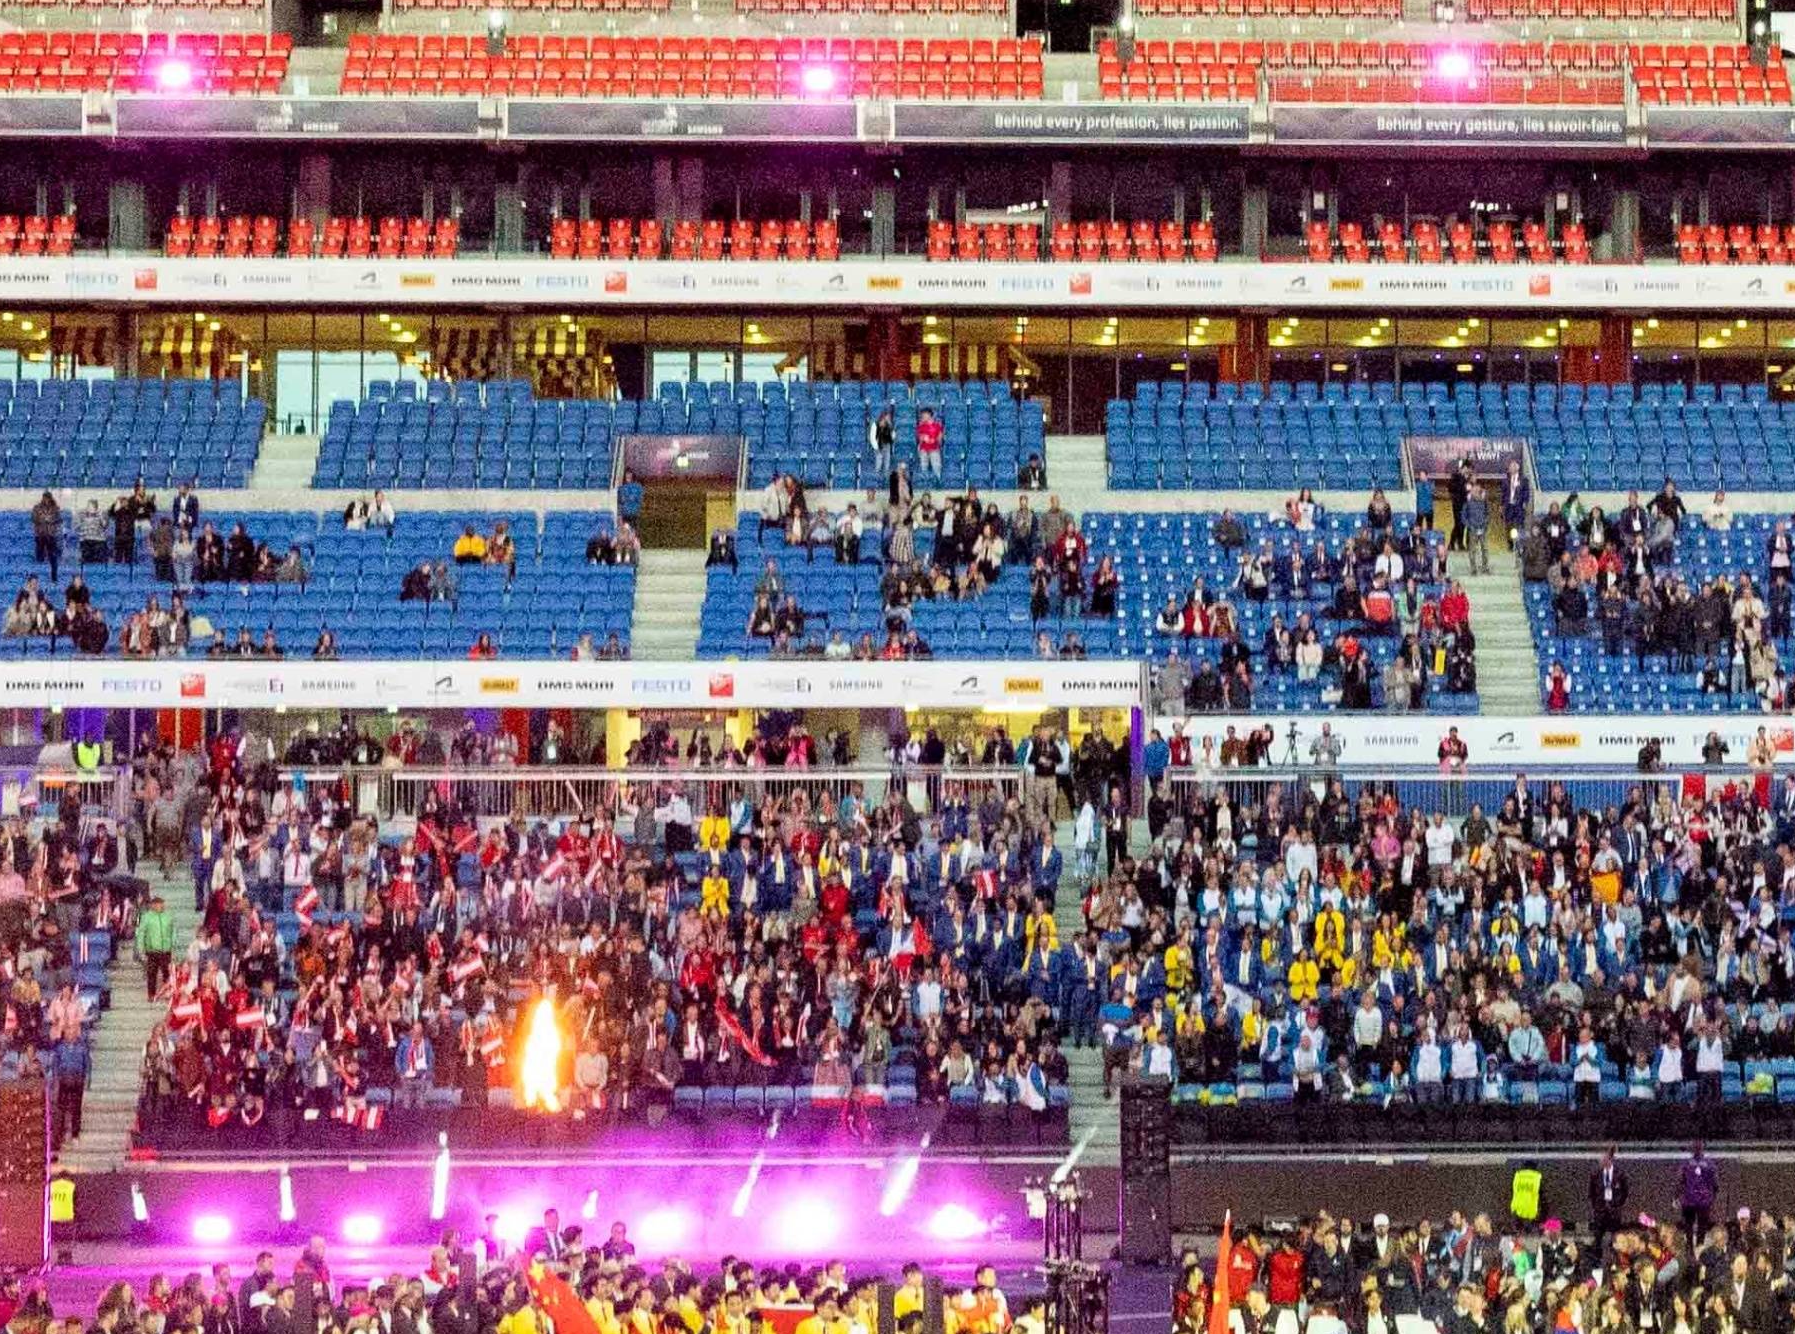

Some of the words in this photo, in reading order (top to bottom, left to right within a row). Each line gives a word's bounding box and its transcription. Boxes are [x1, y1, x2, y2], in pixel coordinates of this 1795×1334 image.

[995, 114, 1043, 128] Behind
[1046, 117, 1083, 131] every
[1086, 114, 1160, 132] profession,
[1164, 116, 1185, 129] lies
[1189, 117, 1242, 132] passion.
[1377, 116, 1421, 131] Behind
[1426, 120, 1462, 134] every
[1466, 120, 1519, 134] gesture,
[1524, 118, 1544, 132] lies
[1548, 118, 1622, 133] savoir-faire.
[5, 680, 41, 690] DMG
[44, 680, 84, 690] MORI
[537, 682, 572, 690] DMG
[575, 682, 614, 690] MORI
[1062, 681, 1097, 690] DMG
[1100, 681, 1139, 690] MORI
[1598, 737, 1633, 746] DMG
[1637, 737, 1676, 746] MORI
